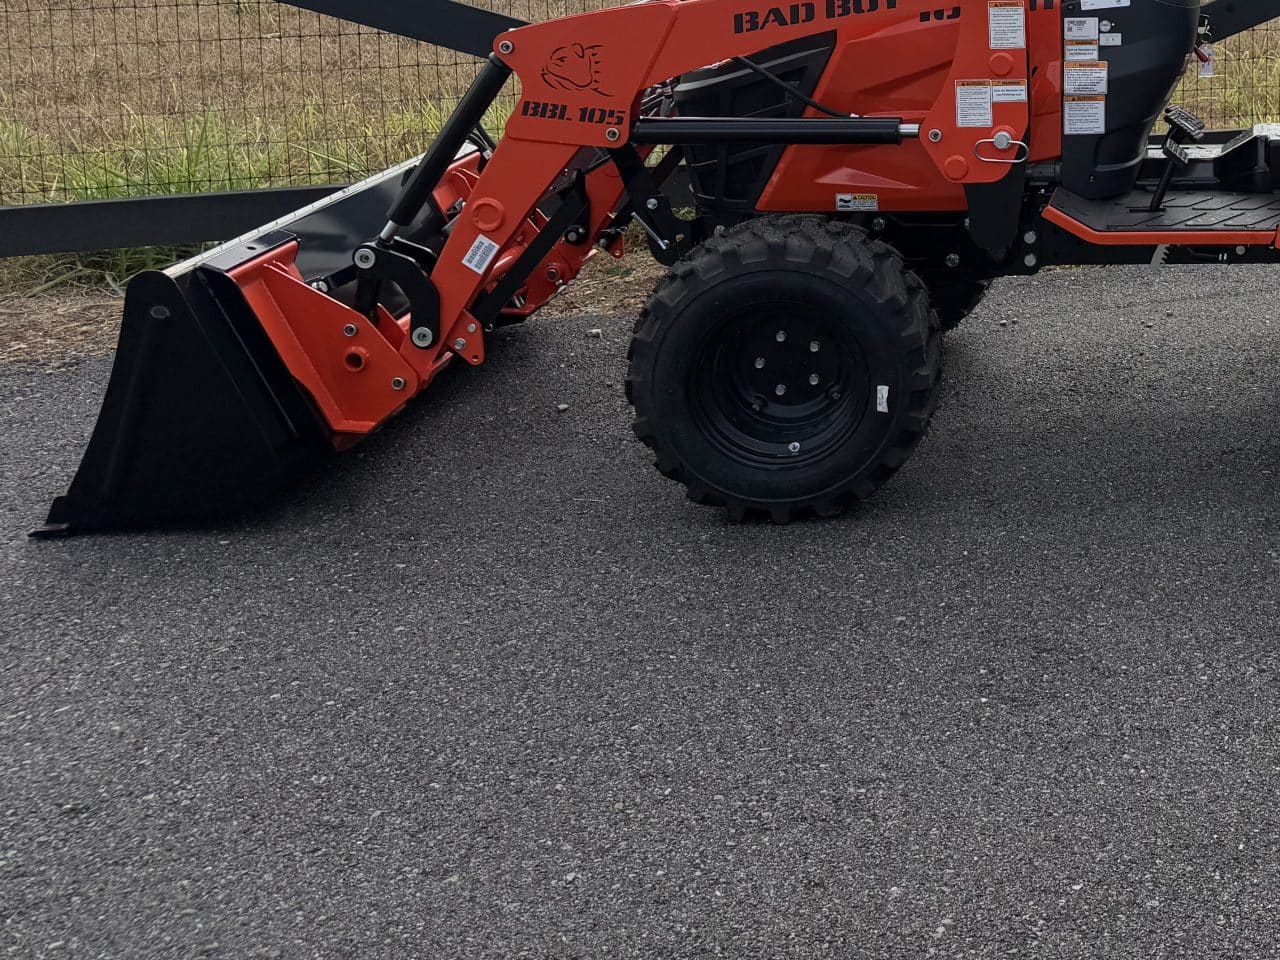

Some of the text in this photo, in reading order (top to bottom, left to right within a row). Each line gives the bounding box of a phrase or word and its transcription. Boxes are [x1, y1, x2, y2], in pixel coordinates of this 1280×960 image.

[733, 2, 815, 34] BAD
[521, 100, 626, 126] BBL 105
